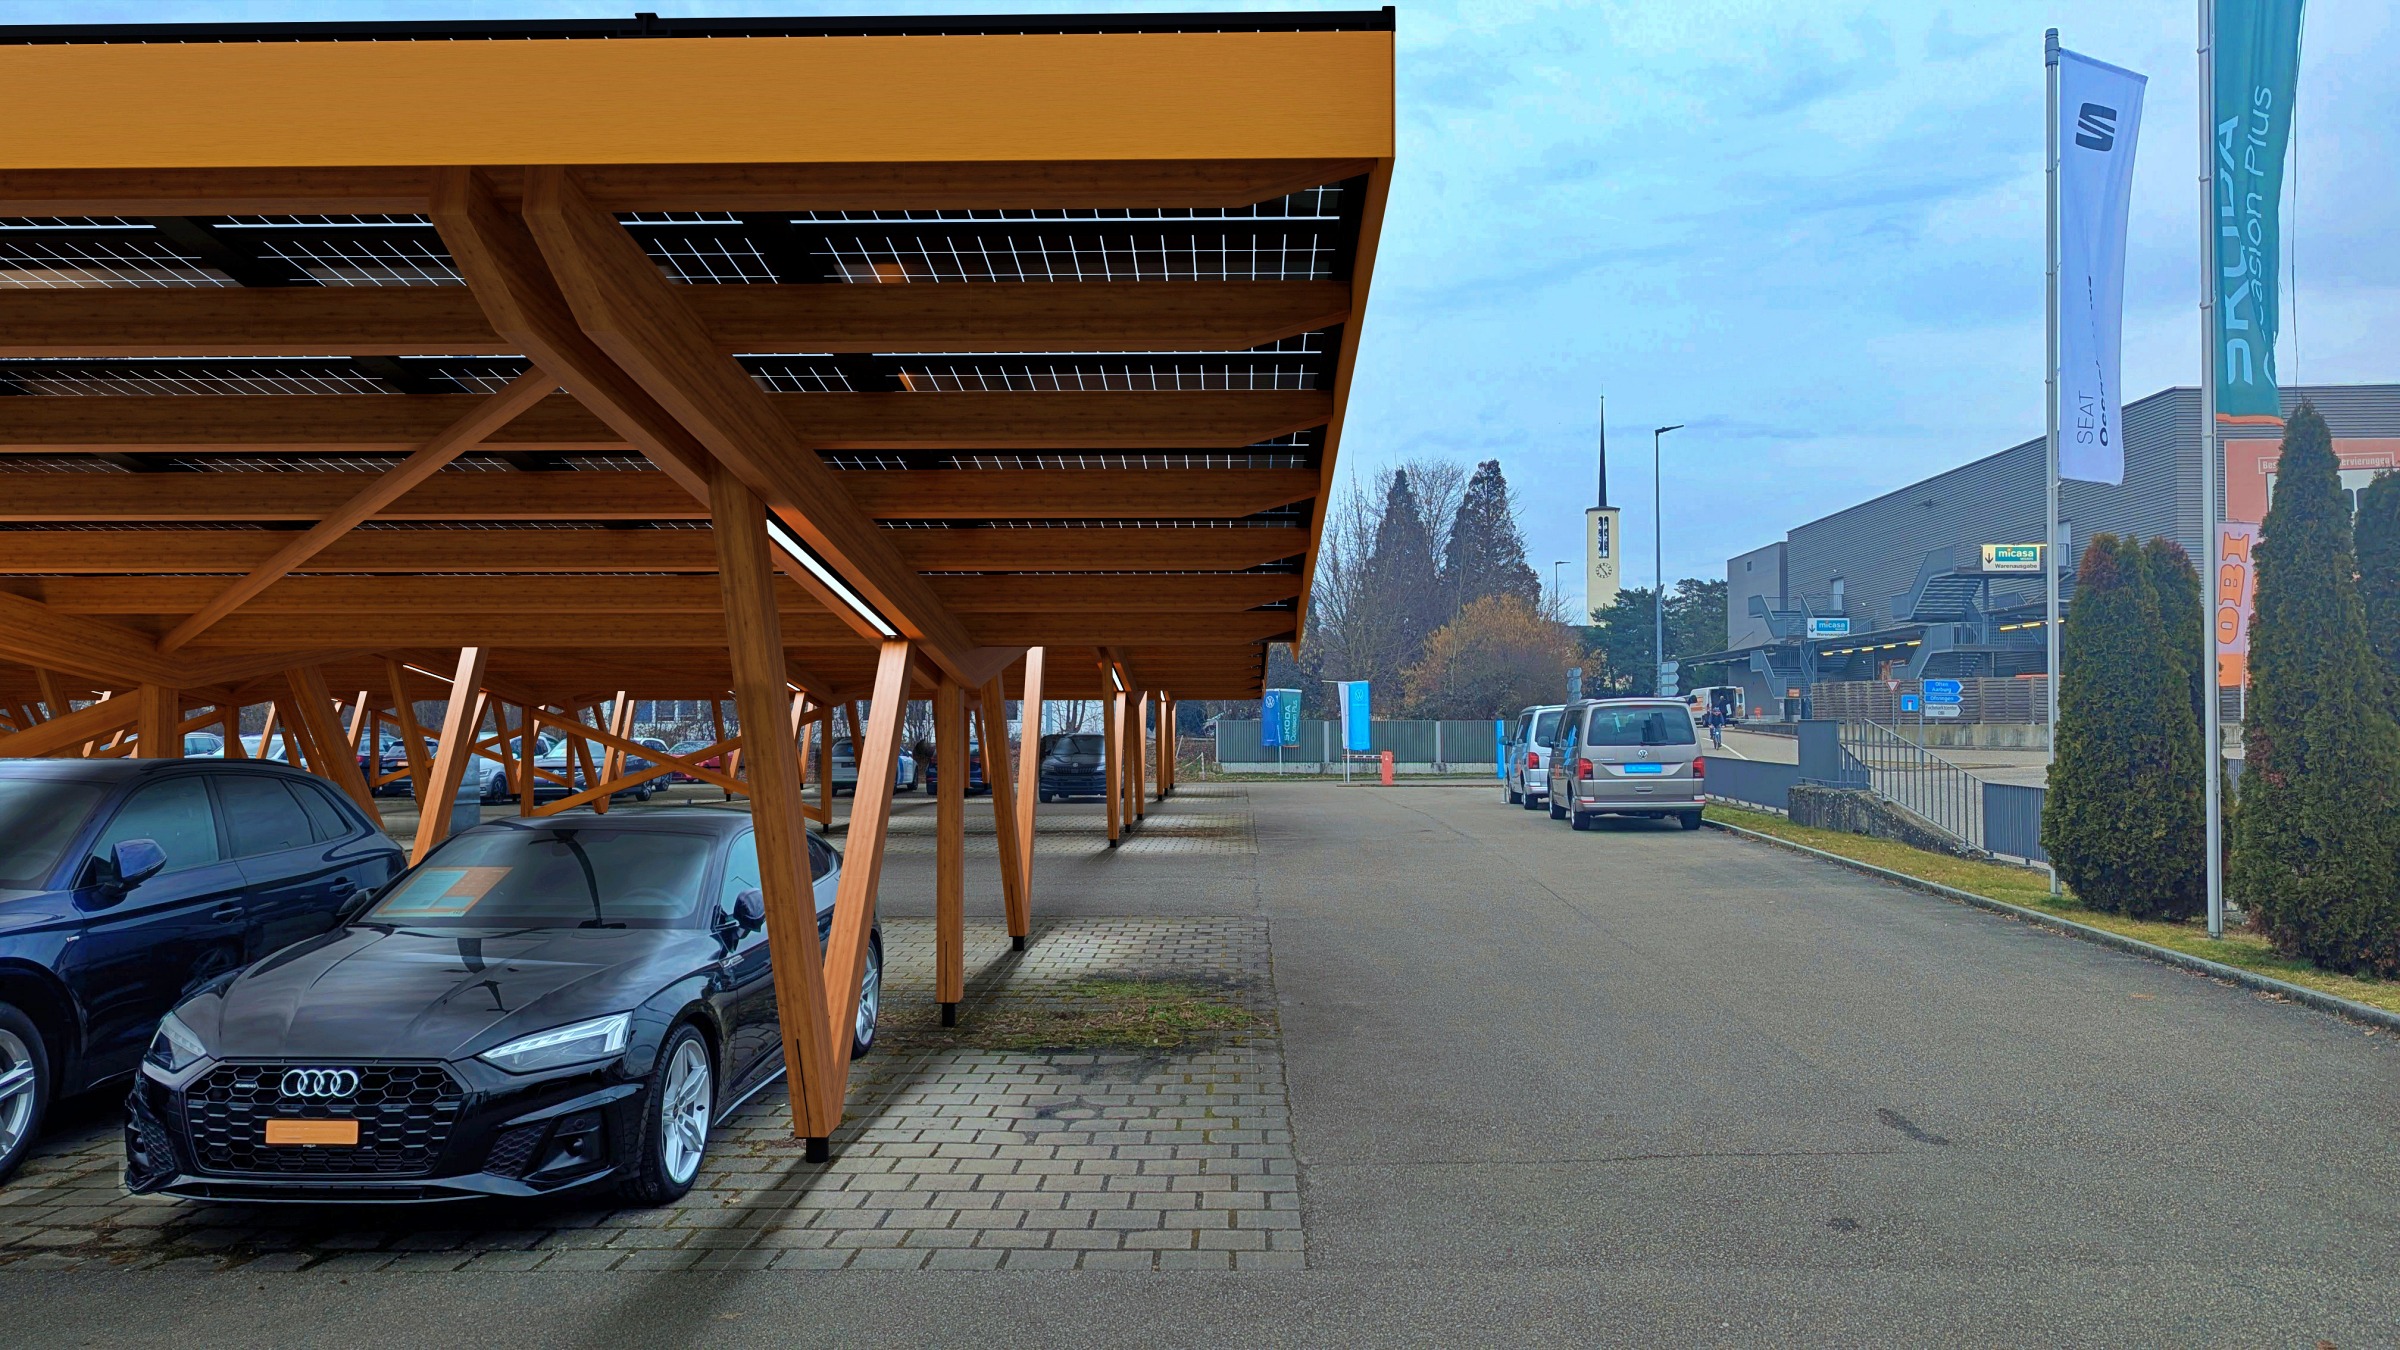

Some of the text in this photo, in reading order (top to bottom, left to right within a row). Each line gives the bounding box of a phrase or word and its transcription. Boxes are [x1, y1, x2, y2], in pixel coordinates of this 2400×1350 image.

[2244, 85, 2272, 177] Plus
[2077, 390, 2094, 445] SEAT
[2340, 456, 2390, 467] ervierungen
[1998, 548, 2034, 558] micasa
[2217, 532, 2250, 645] OBI
